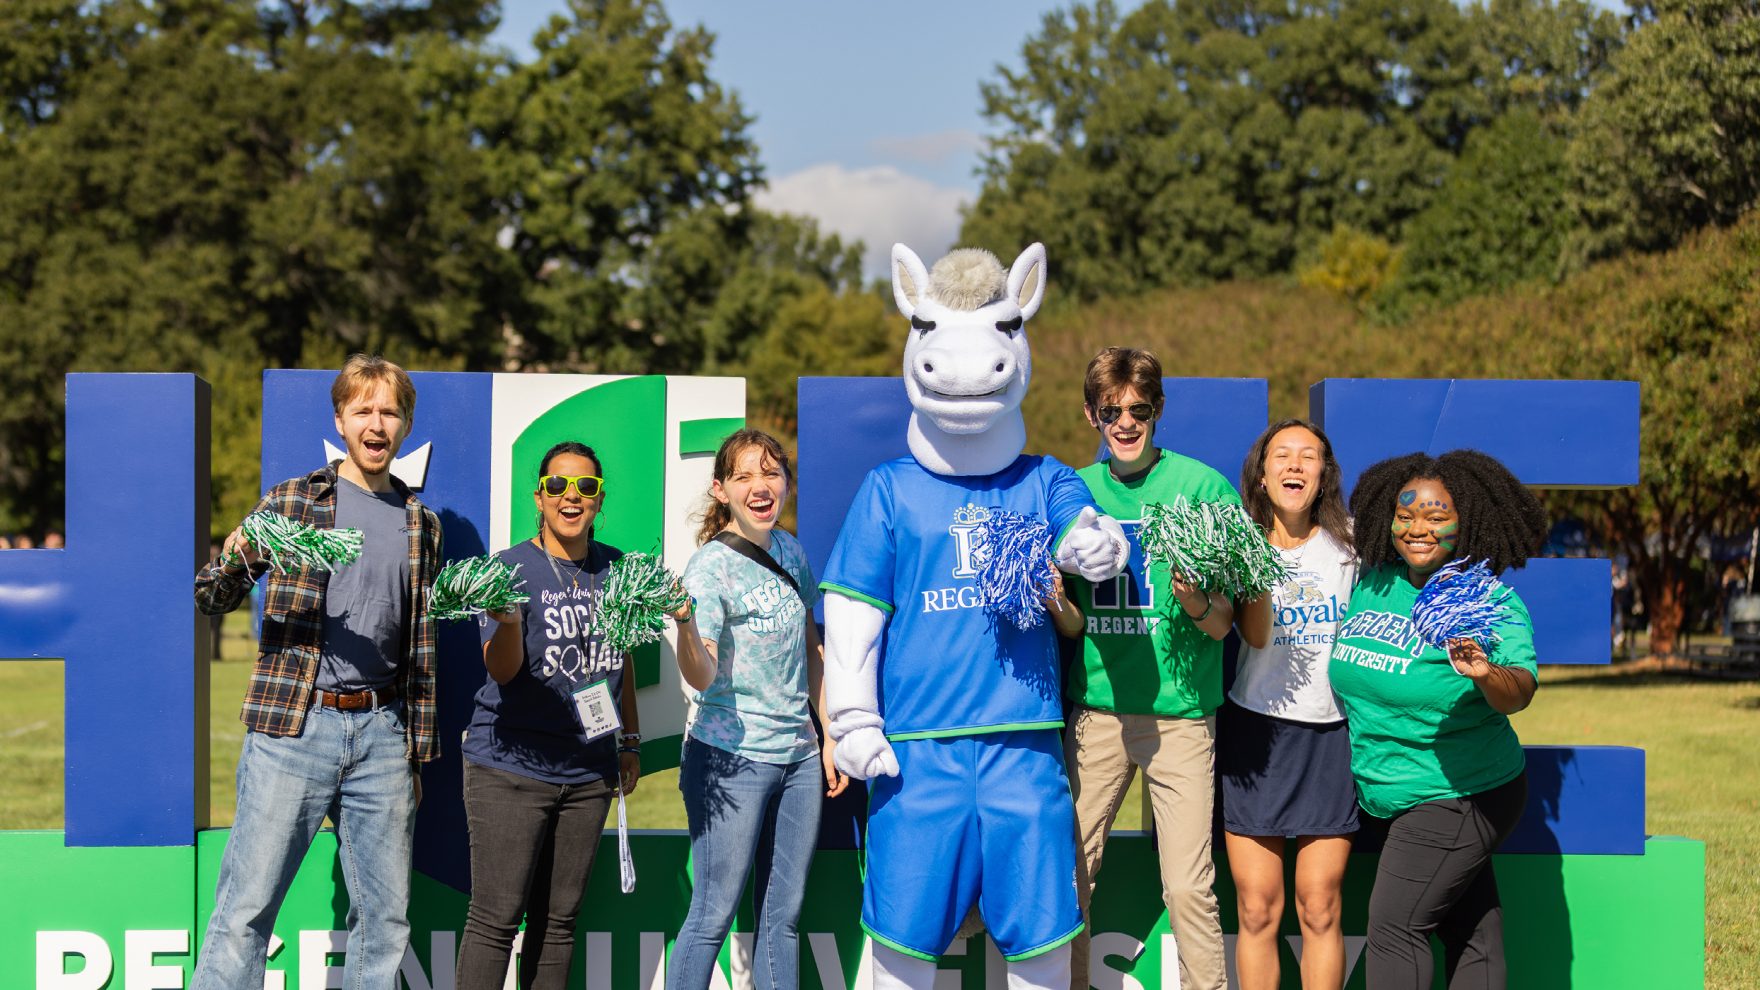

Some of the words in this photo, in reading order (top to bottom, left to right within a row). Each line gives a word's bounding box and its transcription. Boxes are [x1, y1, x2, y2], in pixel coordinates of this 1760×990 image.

[921, 586, 988, 613] REG
[543, 603, 604, 641] SOC
[1086, 616, 1160, 635] REGENT
[1337, 609, 1426, 659] REGENT
[1273, 634, 1336, 646] ATHLETICS
[1332, 641, 1413, 675] UNIVERSITY
[35, 930, 523, 990] REEN
